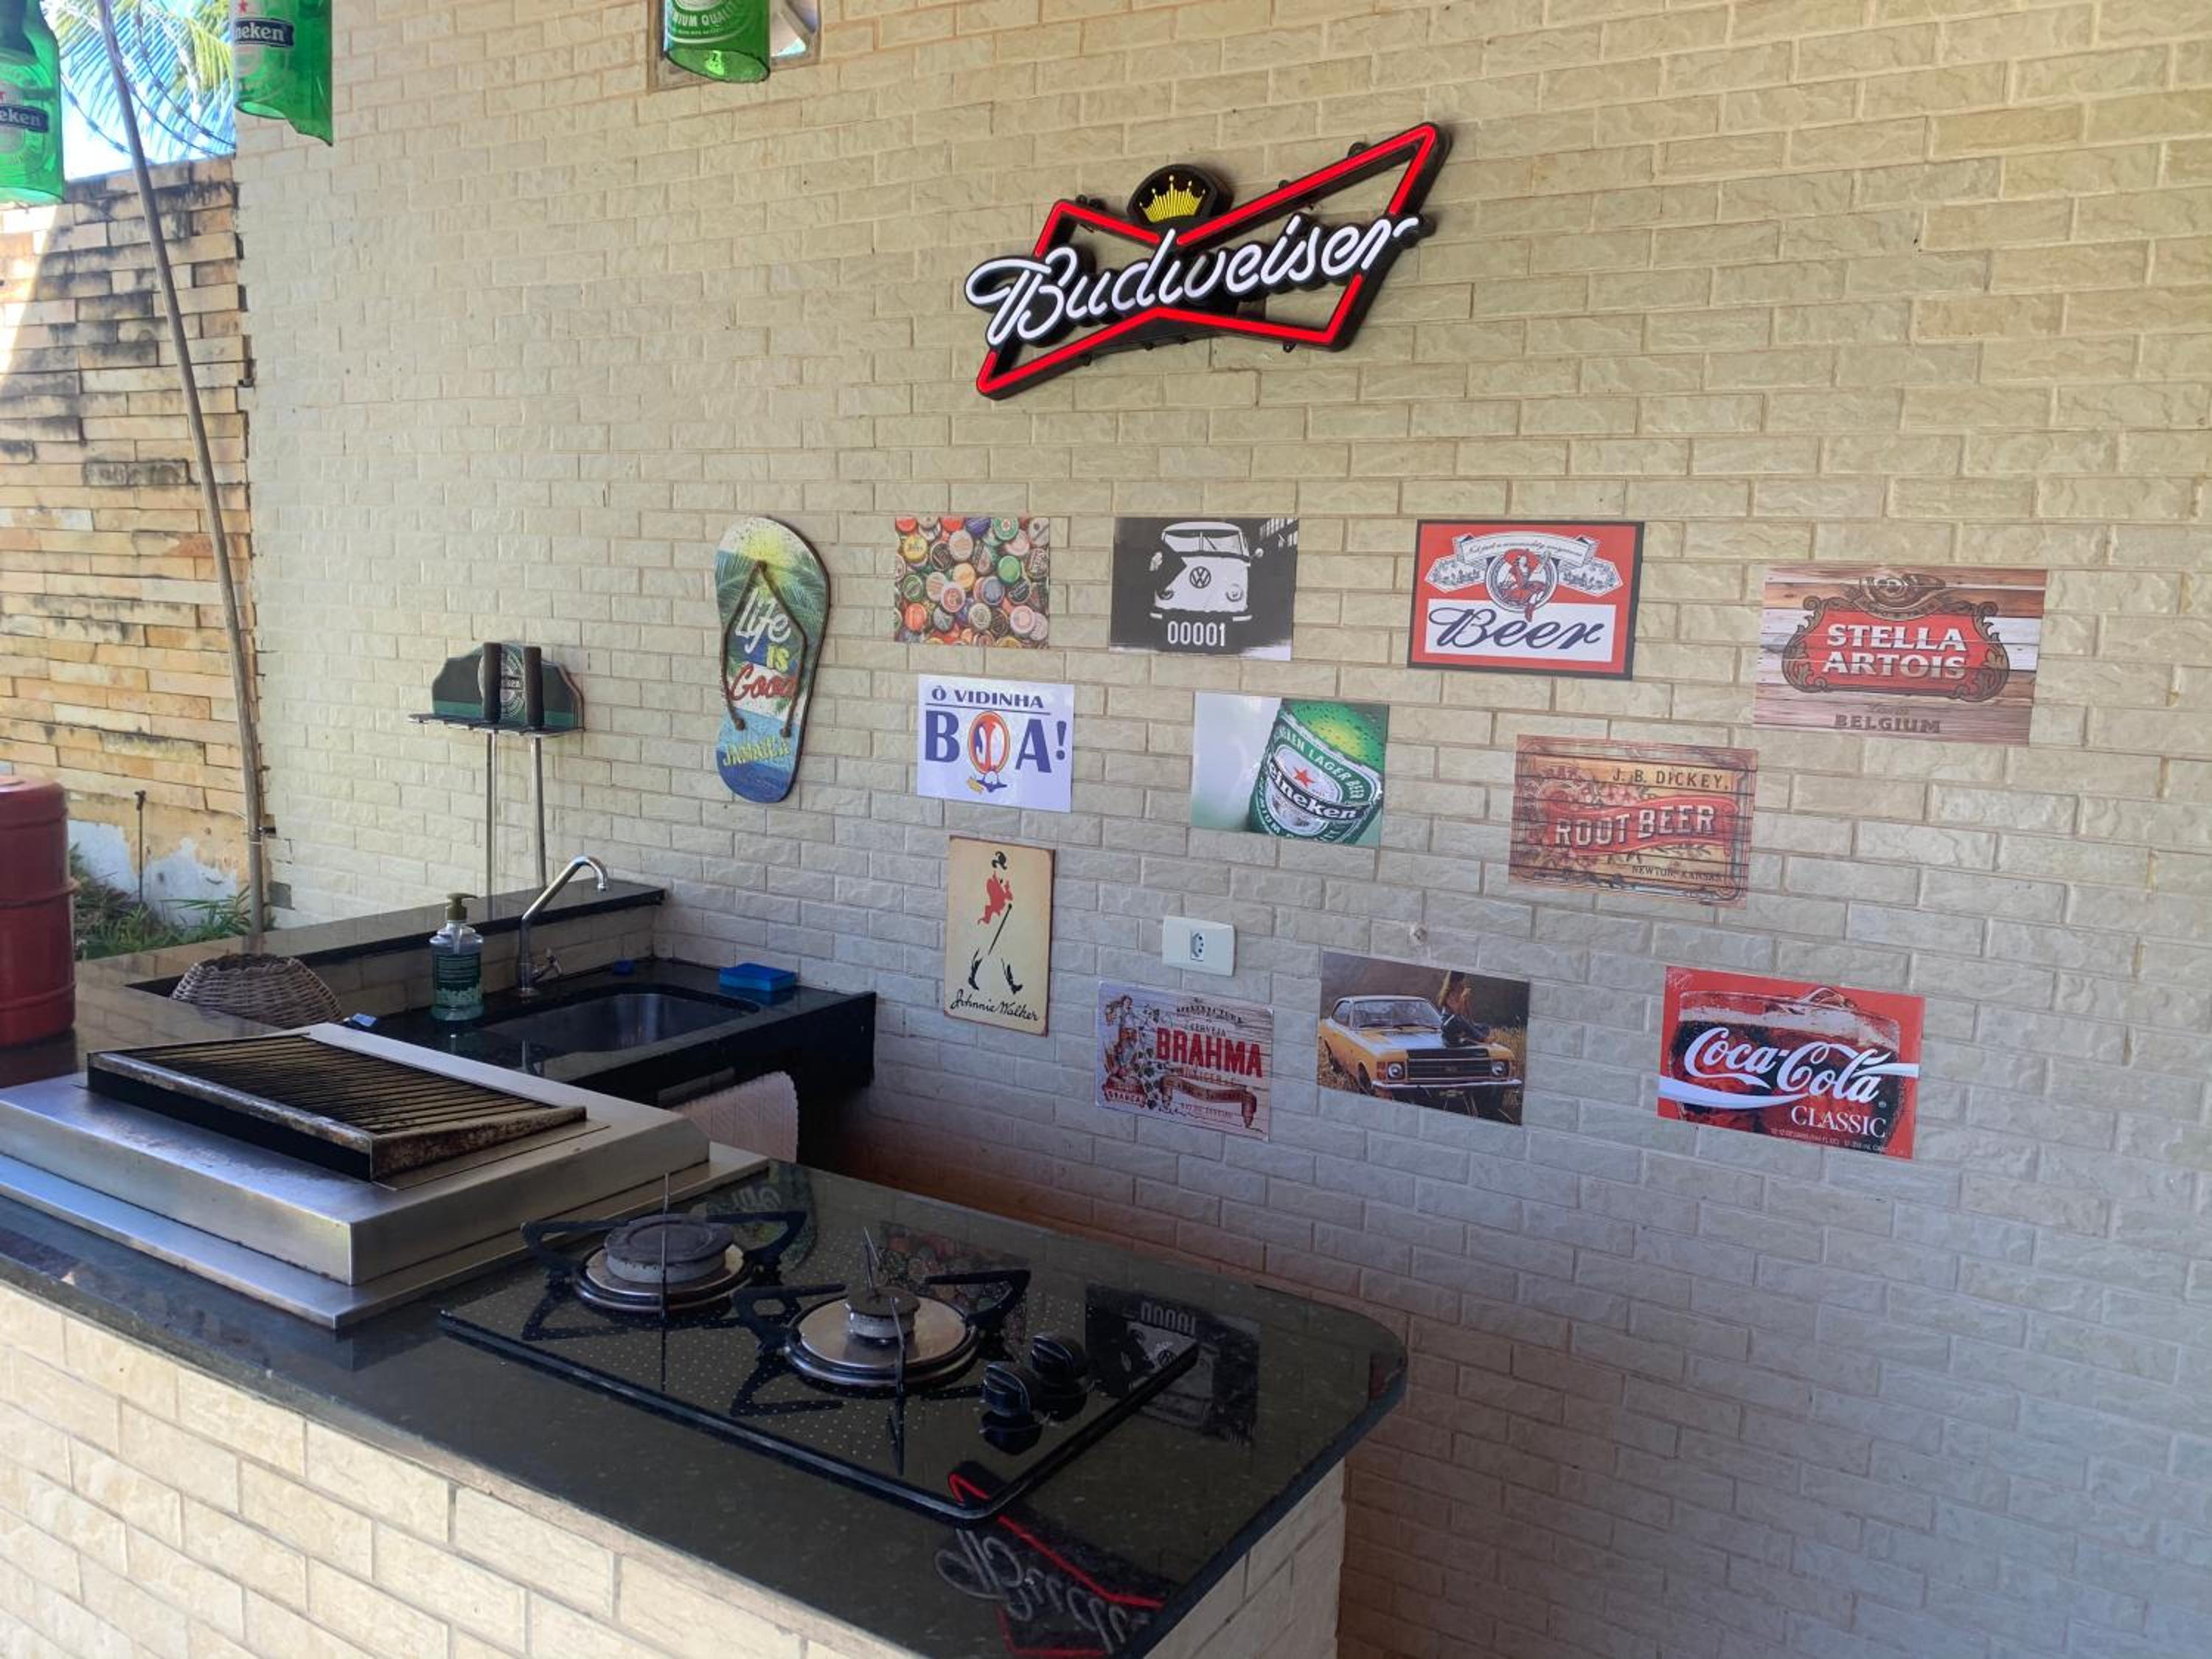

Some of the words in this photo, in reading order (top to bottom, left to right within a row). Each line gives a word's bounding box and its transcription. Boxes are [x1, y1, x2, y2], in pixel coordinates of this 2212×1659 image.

[964, 214, 1420, 347] Budweiser
[1166, 620, 1227, 647] 00001
[1427, 607, 1605, 650] Beer
[1826, 622, 1967, 652] STELLA
[1822, 650, 1967, 680] ARTOIS
[953, 689, 1044, 709] VIDINHA
[1834, 714, 1941, 734] BELGIUM
[1308, 748, 1352, 782] LAGER
[1554, 813, 1632, 846] ROOT
[1637, 804, 1715, 840] BEER
[995, 1001, 1039, 1022] Walker
[1155, 1026, 1264, 1079] BRAHMA
[1683, 1026, 1889, 1105] Coca-Cola
[1790, 1105, 1888, 1138] CLASSIC
